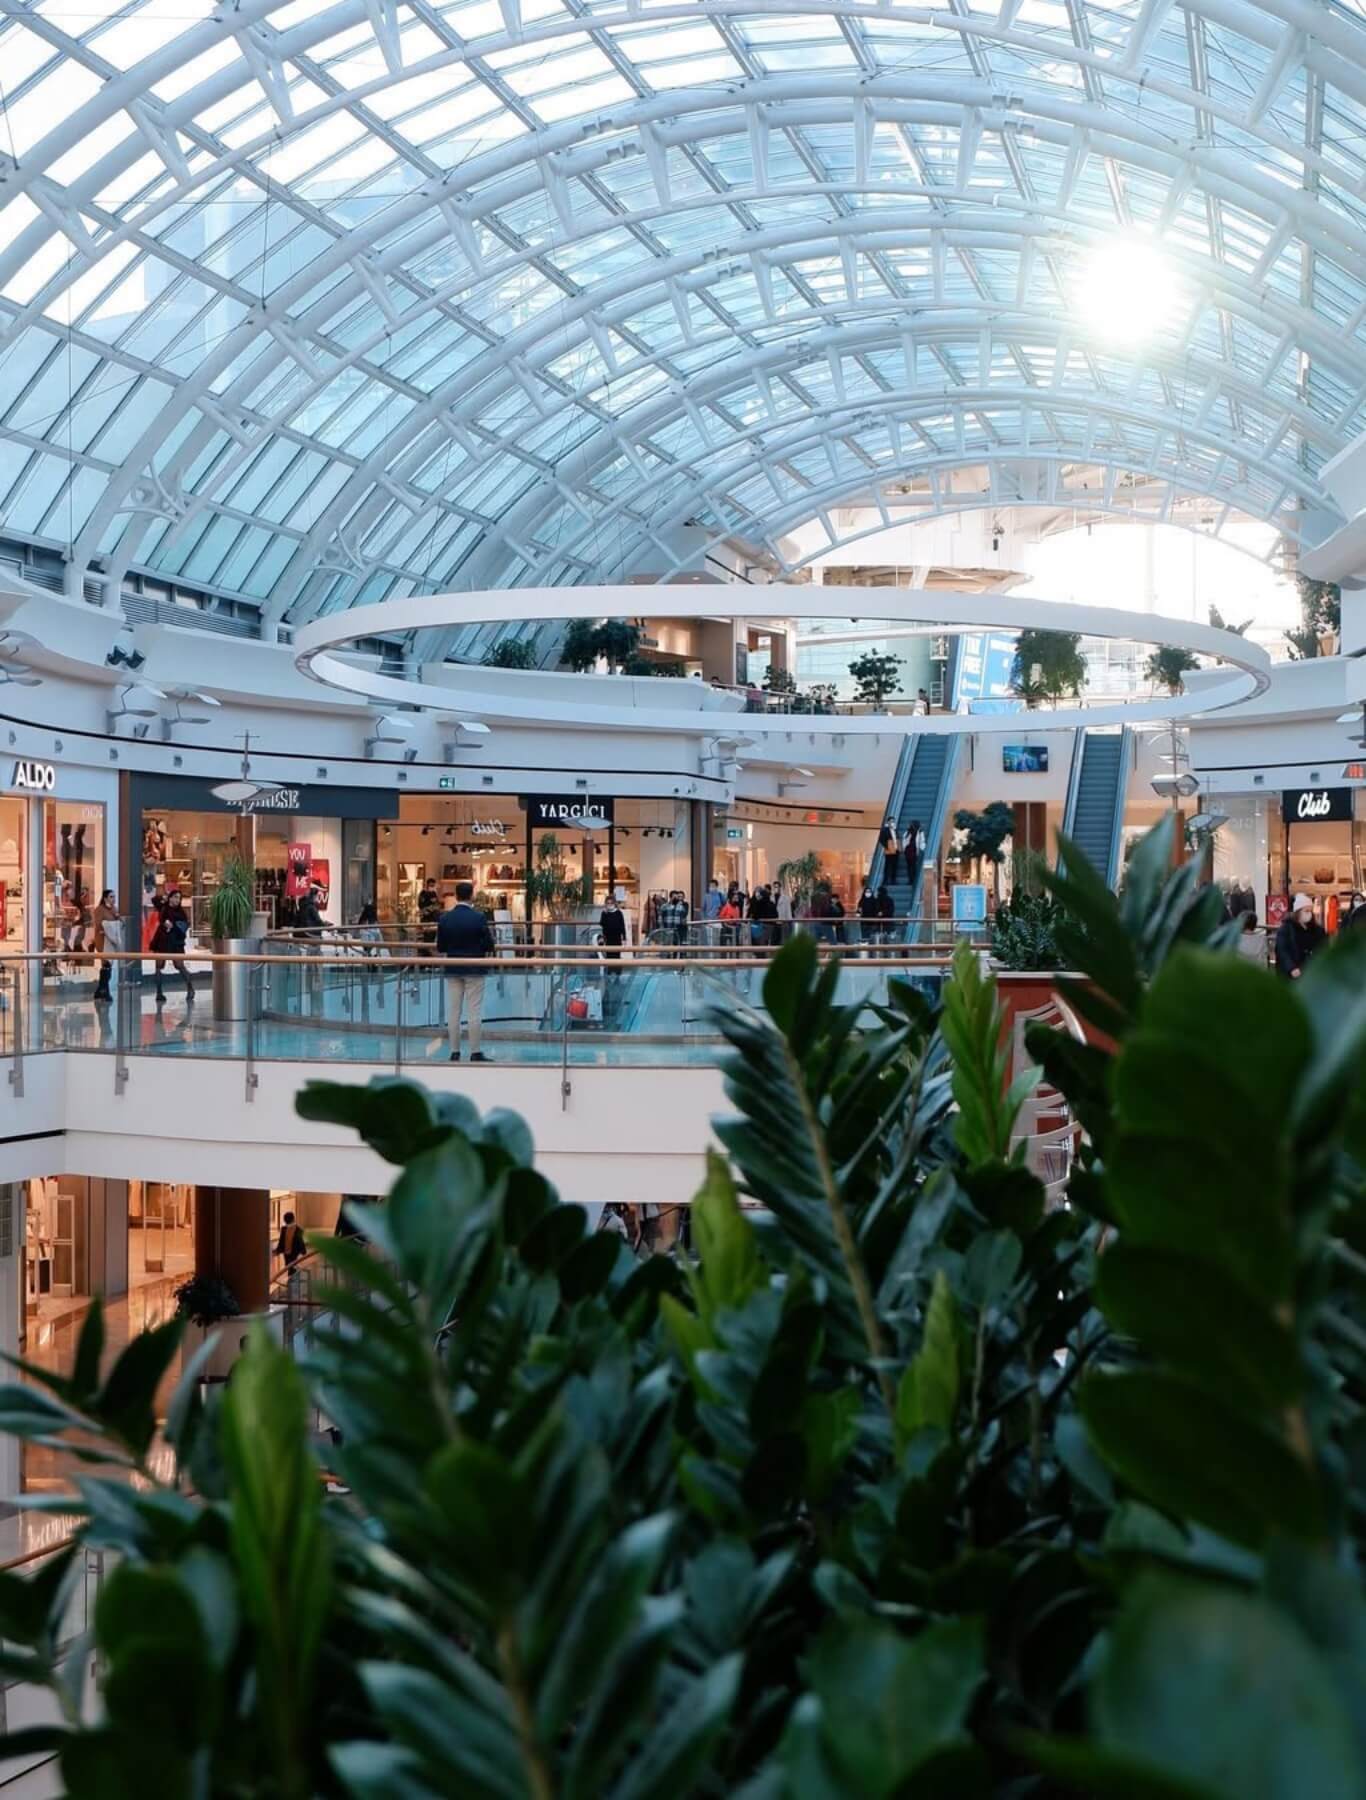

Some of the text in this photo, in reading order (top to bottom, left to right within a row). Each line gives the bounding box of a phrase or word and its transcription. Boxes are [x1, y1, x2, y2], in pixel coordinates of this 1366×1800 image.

[14, 761, 55, 790] ALDO
[1297, 792, 1331, 818] Club
[289, 848, 305, 860] YOU
